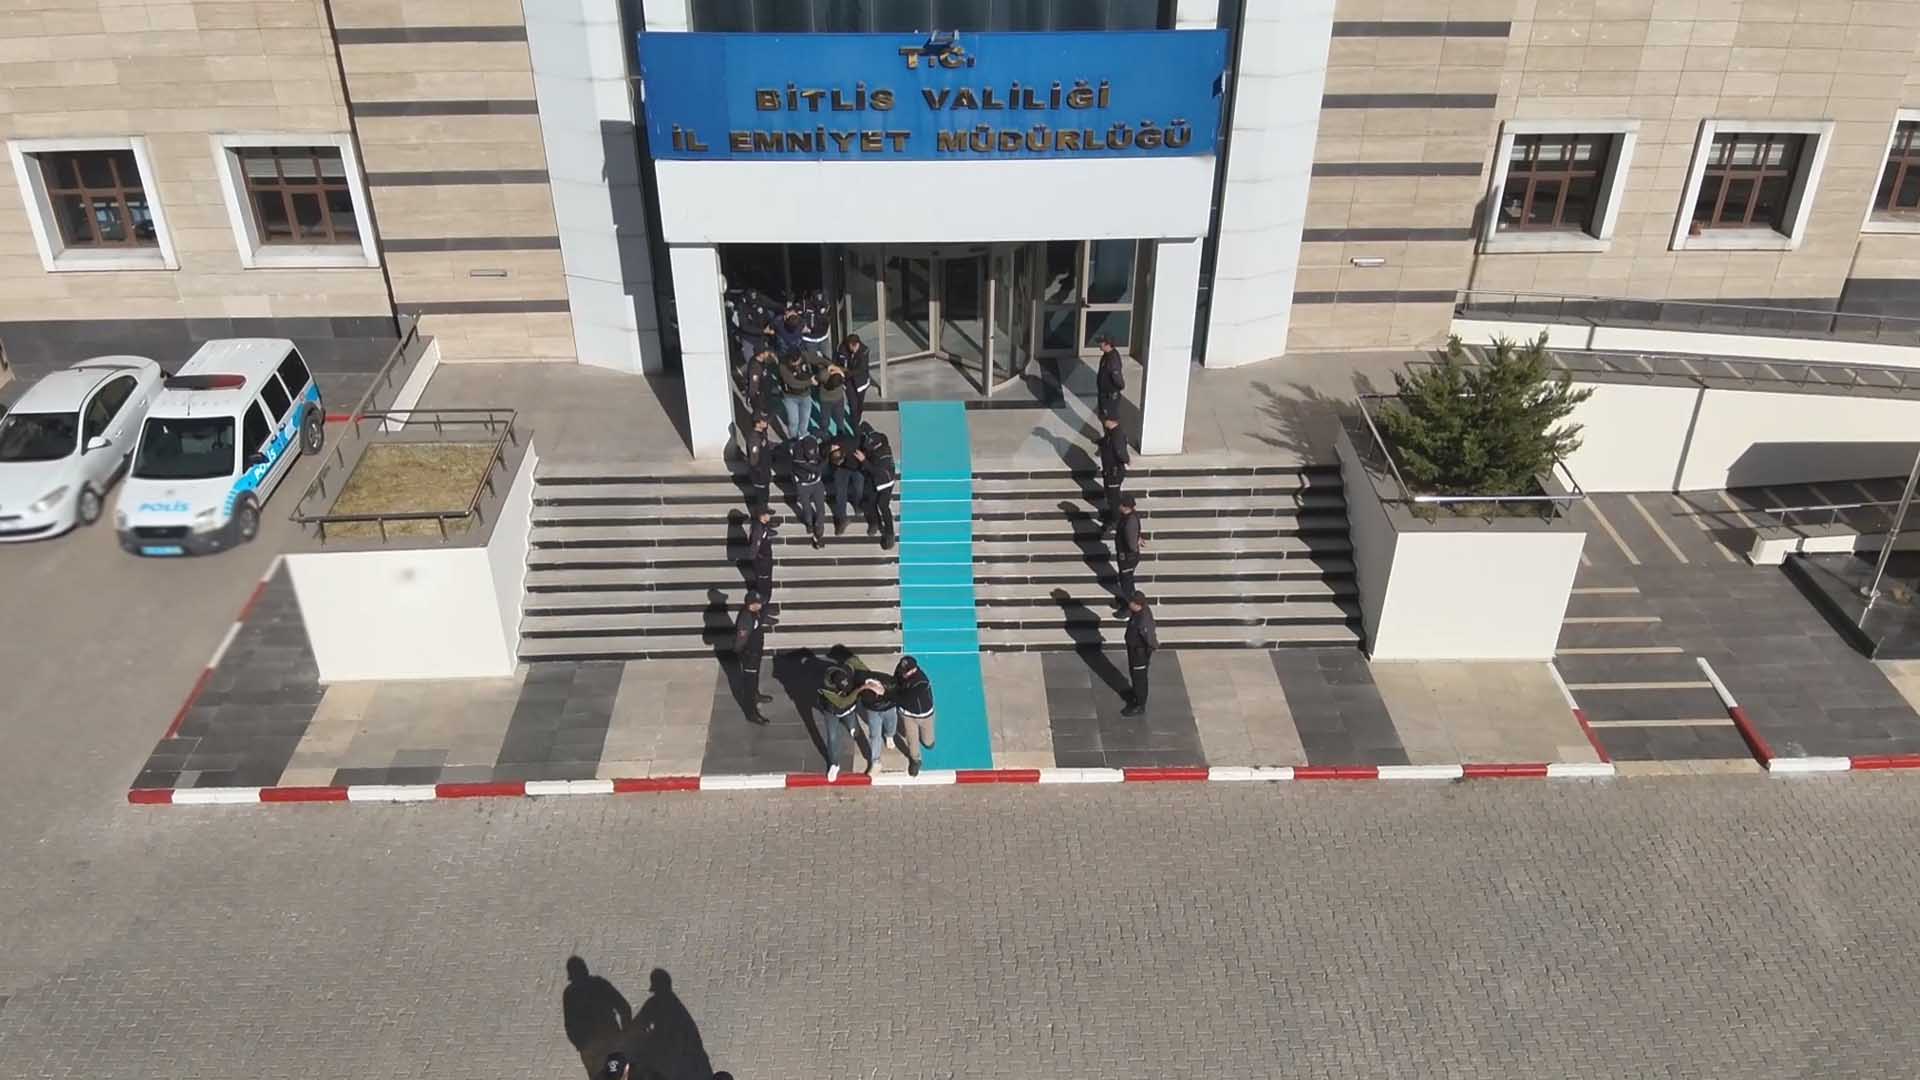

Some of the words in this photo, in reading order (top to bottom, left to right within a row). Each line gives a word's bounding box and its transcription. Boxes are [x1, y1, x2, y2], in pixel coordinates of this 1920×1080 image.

[898, 45, 976, 69] T.C.
[755, 80, 895, 112] BİTLİS
[921, 79, 1110, 111] VALİLİĞİ
[671, 122, 709, 152] İL
[728, 125, 911, 153] EMNİYET
[936, 118, 1192, 153] MÜDÜRLÜĞÜ
